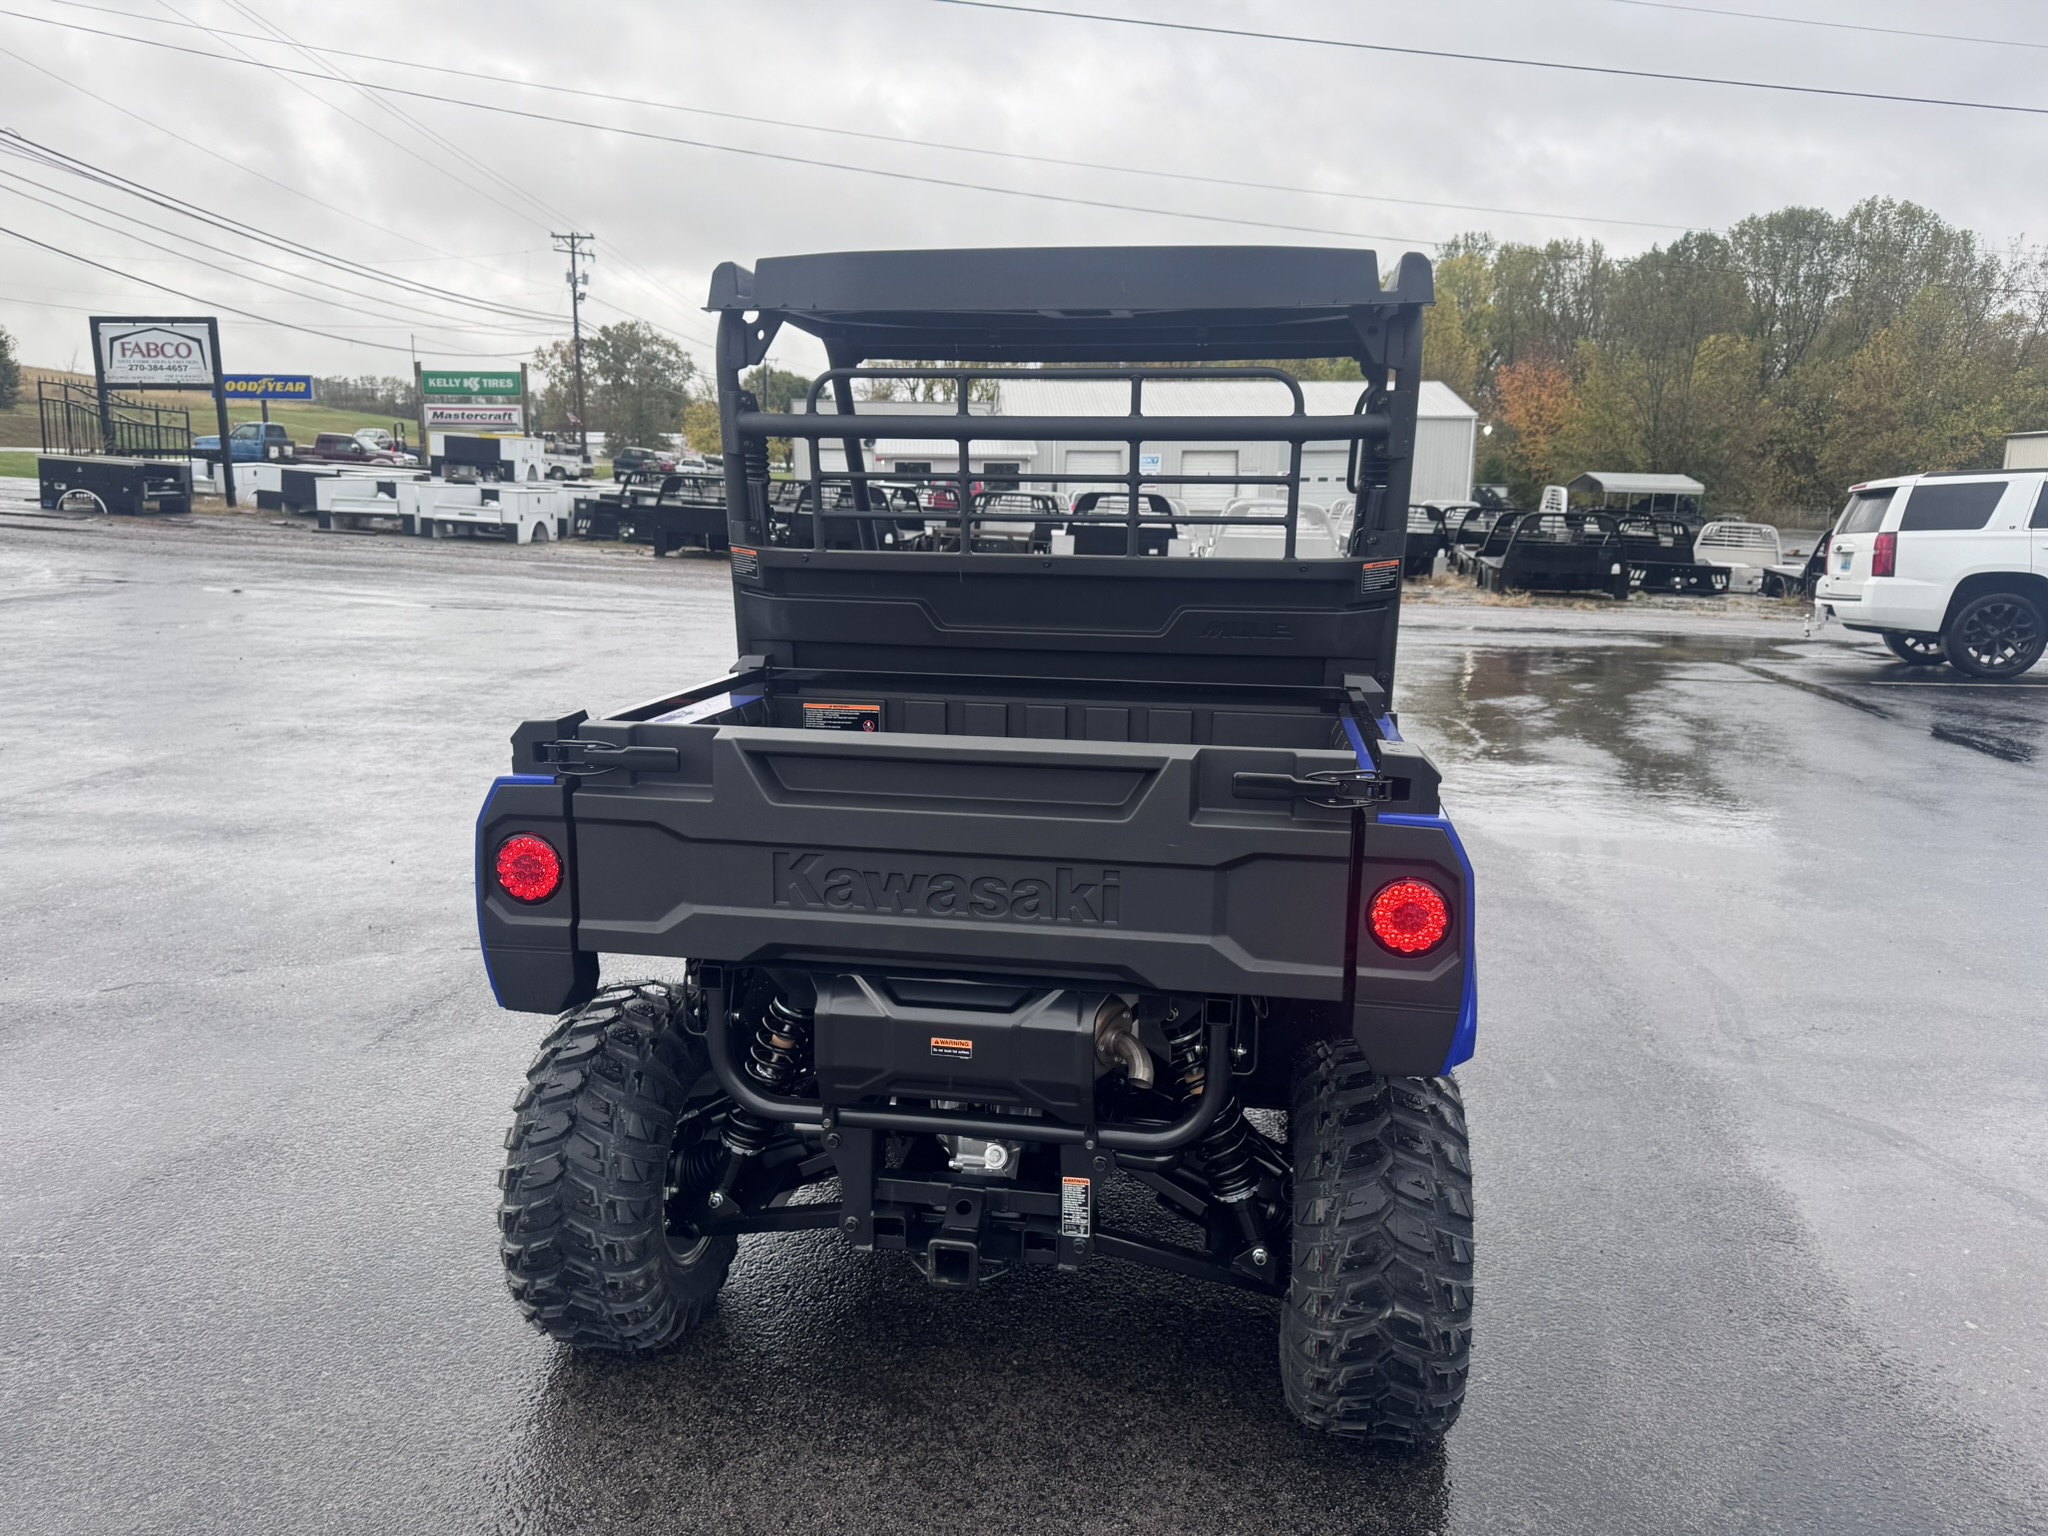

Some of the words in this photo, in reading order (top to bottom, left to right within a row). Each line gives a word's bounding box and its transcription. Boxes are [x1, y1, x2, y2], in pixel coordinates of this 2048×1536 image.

[120, 341, 192, 359] FABCO
[128, 364, 189, 372] 270-384-4657
[225, 379, 307, 393] OODYEAR
[428, 378, 461, 388] KELLY
[482, 378, 514, 388] TIRES
[432, 411, 513, 420] Mastercraft
[772, 851, 1121, 924] Kawasaki
